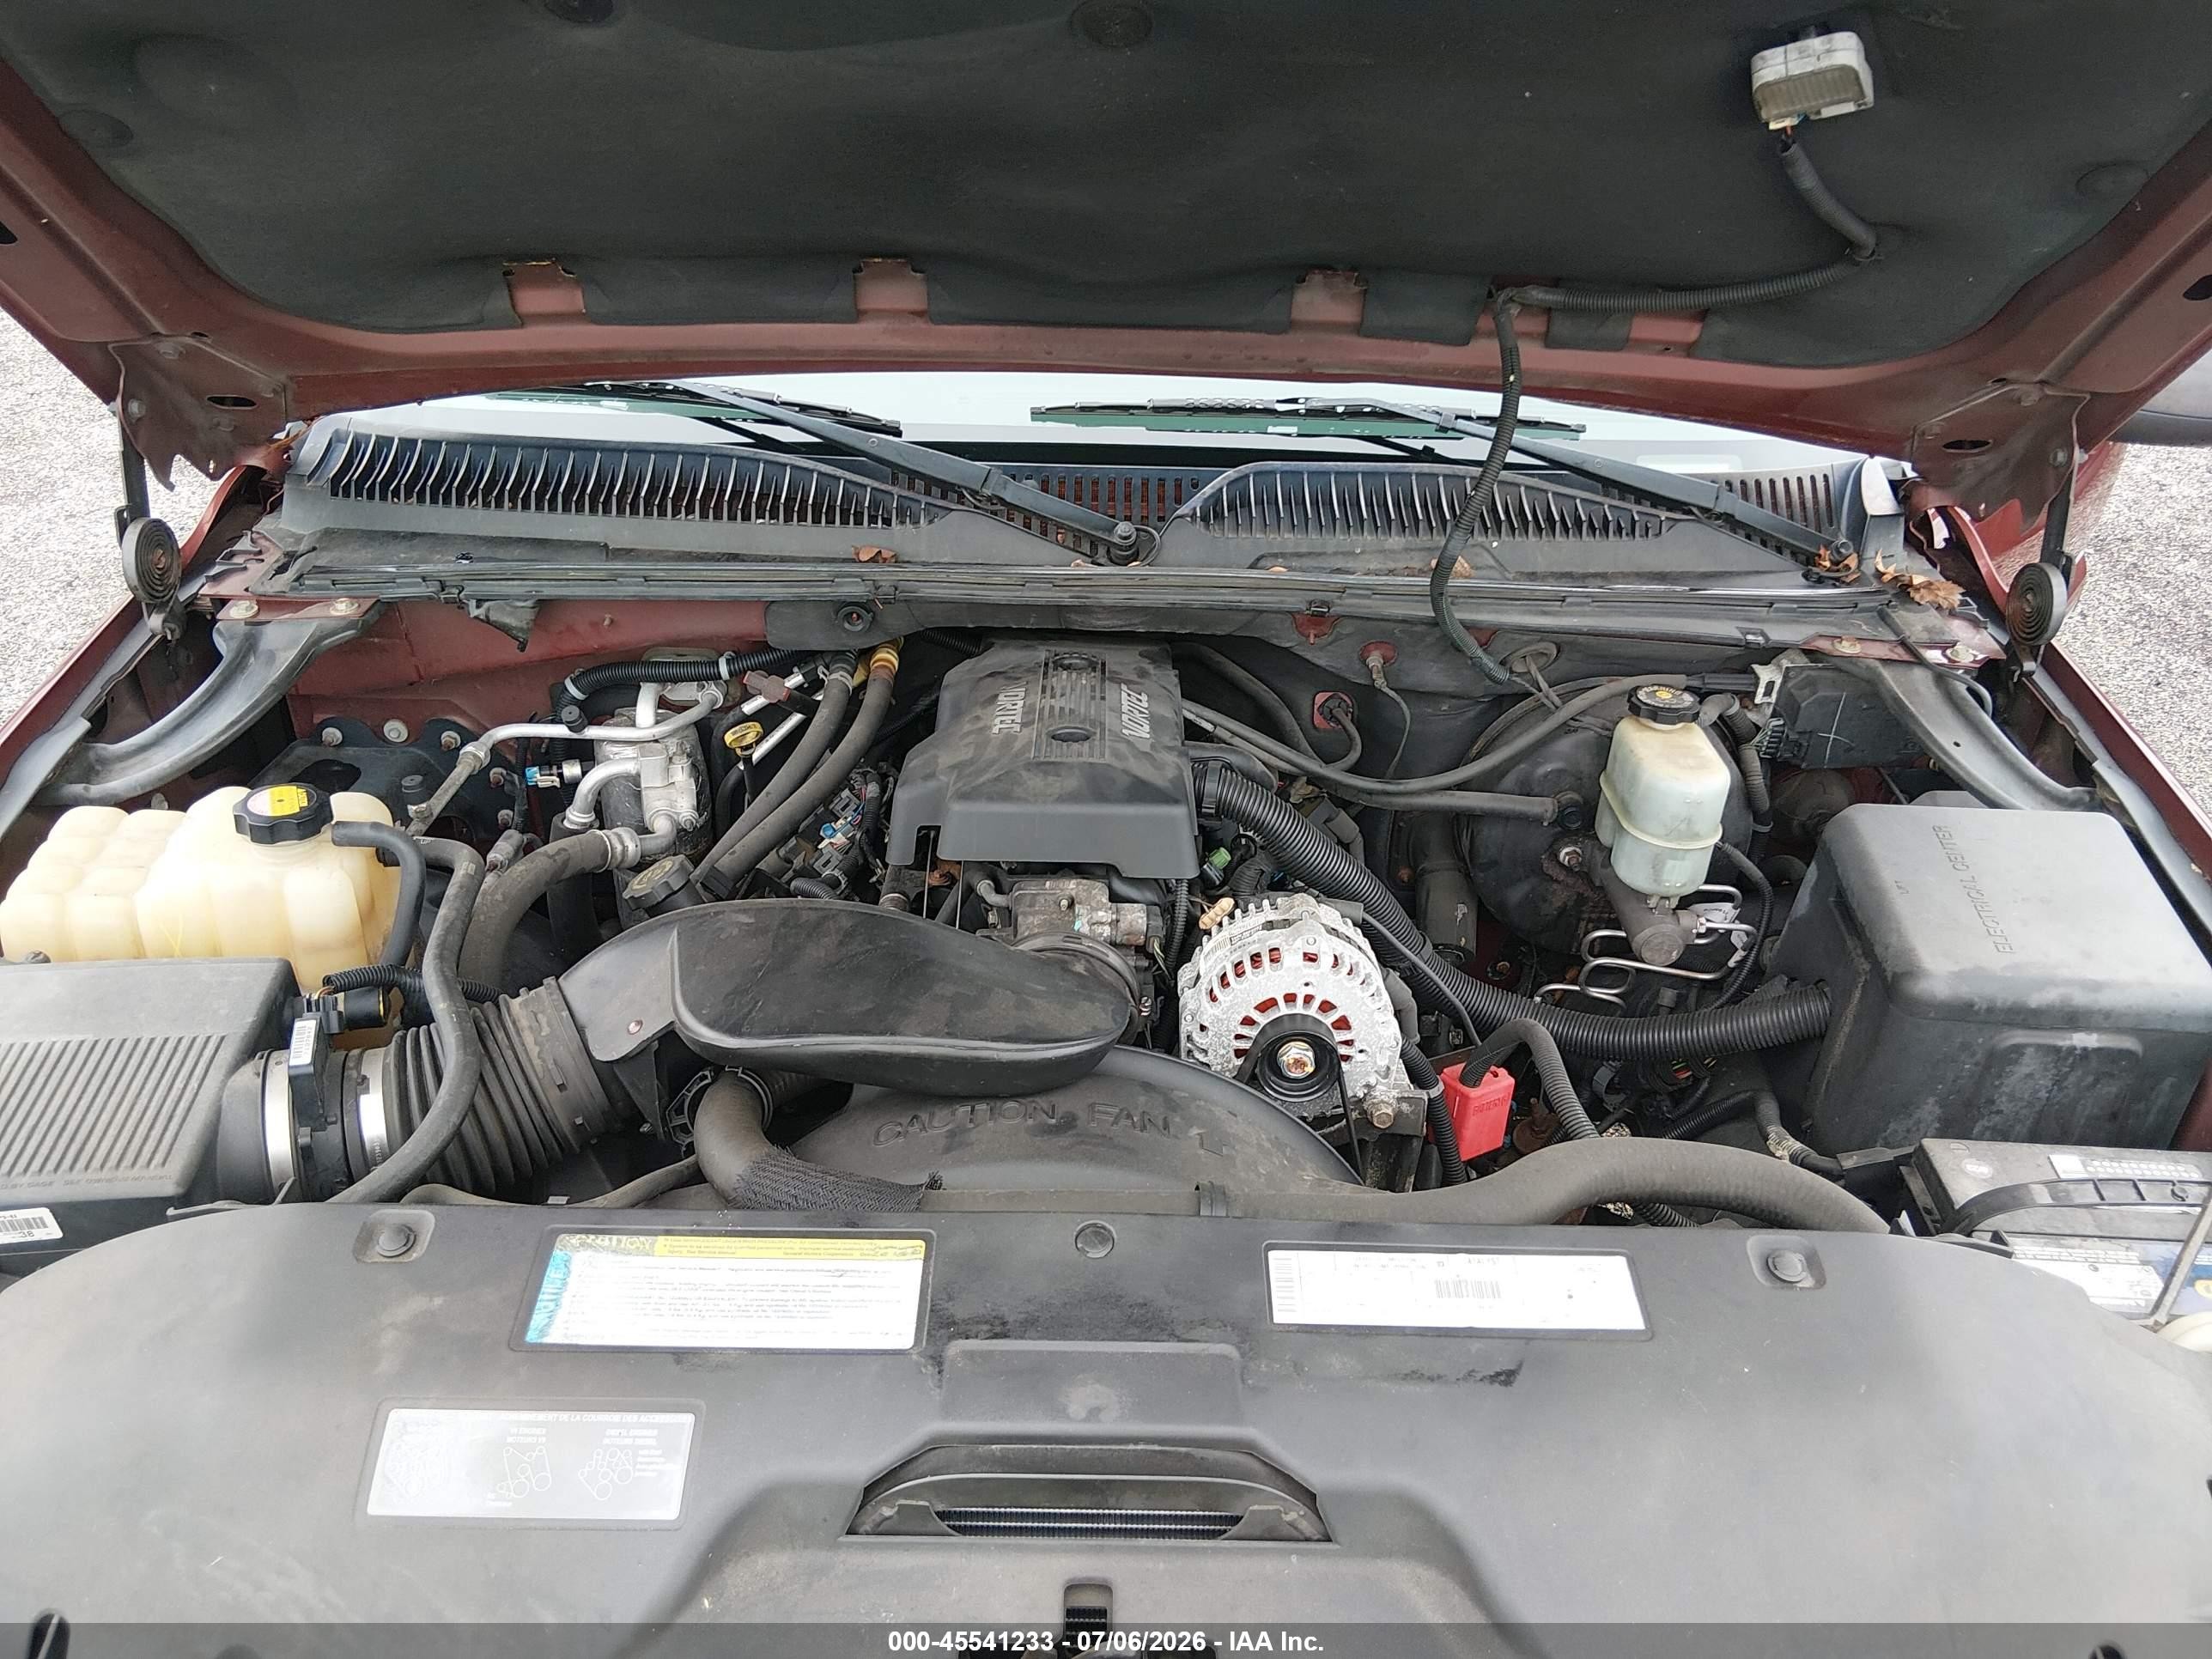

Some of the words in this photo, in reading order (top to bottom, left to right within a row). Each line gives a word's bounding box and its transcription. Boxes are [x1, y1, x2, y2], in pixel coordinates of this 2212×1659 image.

[991, 681, 1028, 735] VORTEC
[1120, 683, 1151, 738] VORTEC
[1931, 824, 1971, 872] CENTER
[1960, 875, 2014, 954] ELECTRICAL
[872, 1099, 1057, 1147] CAUTION
[1088, 1101, 1171, 1139] FAN
